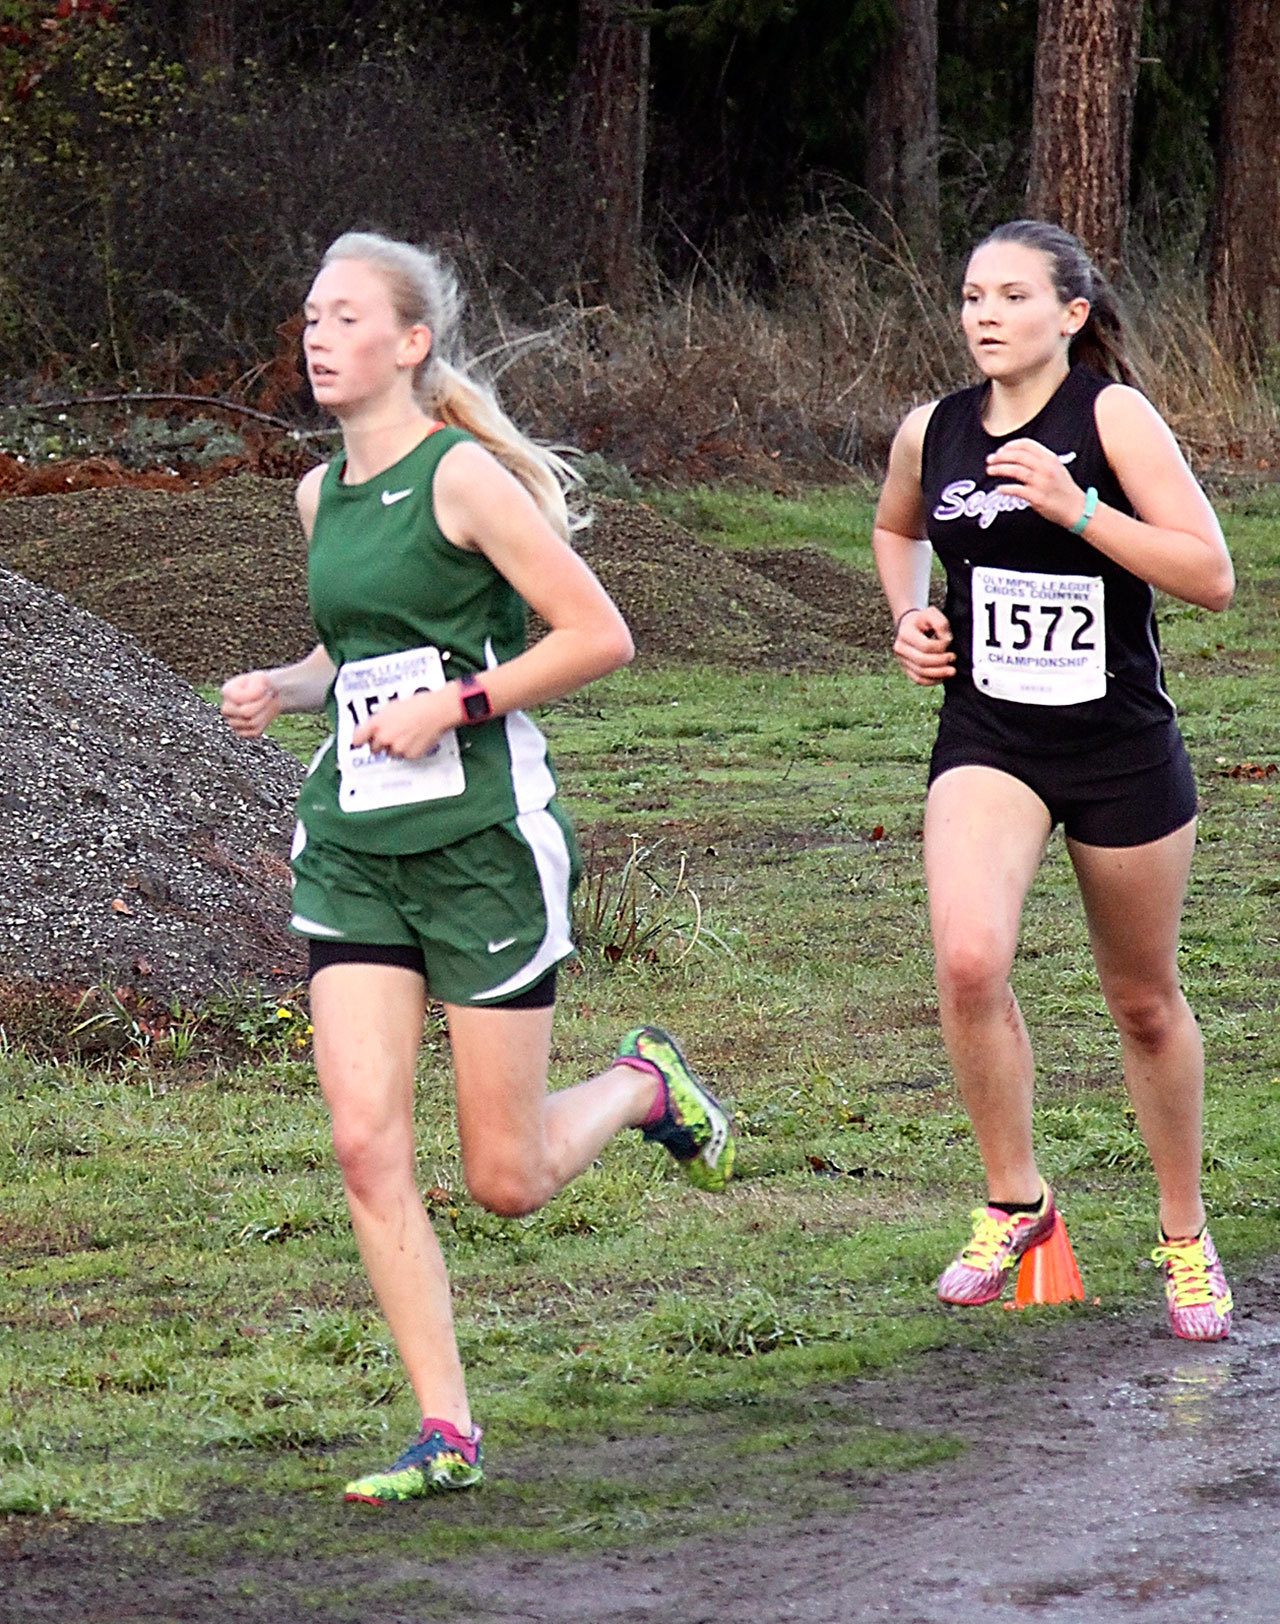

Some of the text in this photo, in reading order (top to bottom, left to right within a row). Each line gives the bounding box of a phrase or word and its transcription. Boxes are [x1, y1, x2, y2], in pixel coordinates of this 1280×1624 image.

[982, 574, 1091, 592] OLYMPIC LEAGUE
[985, 585, 1089, 601] CROSS COUNTRY
[984, 601, 1095, 651] 1572
[988, 653, 1088, 668] CHAMPIONSHIP
